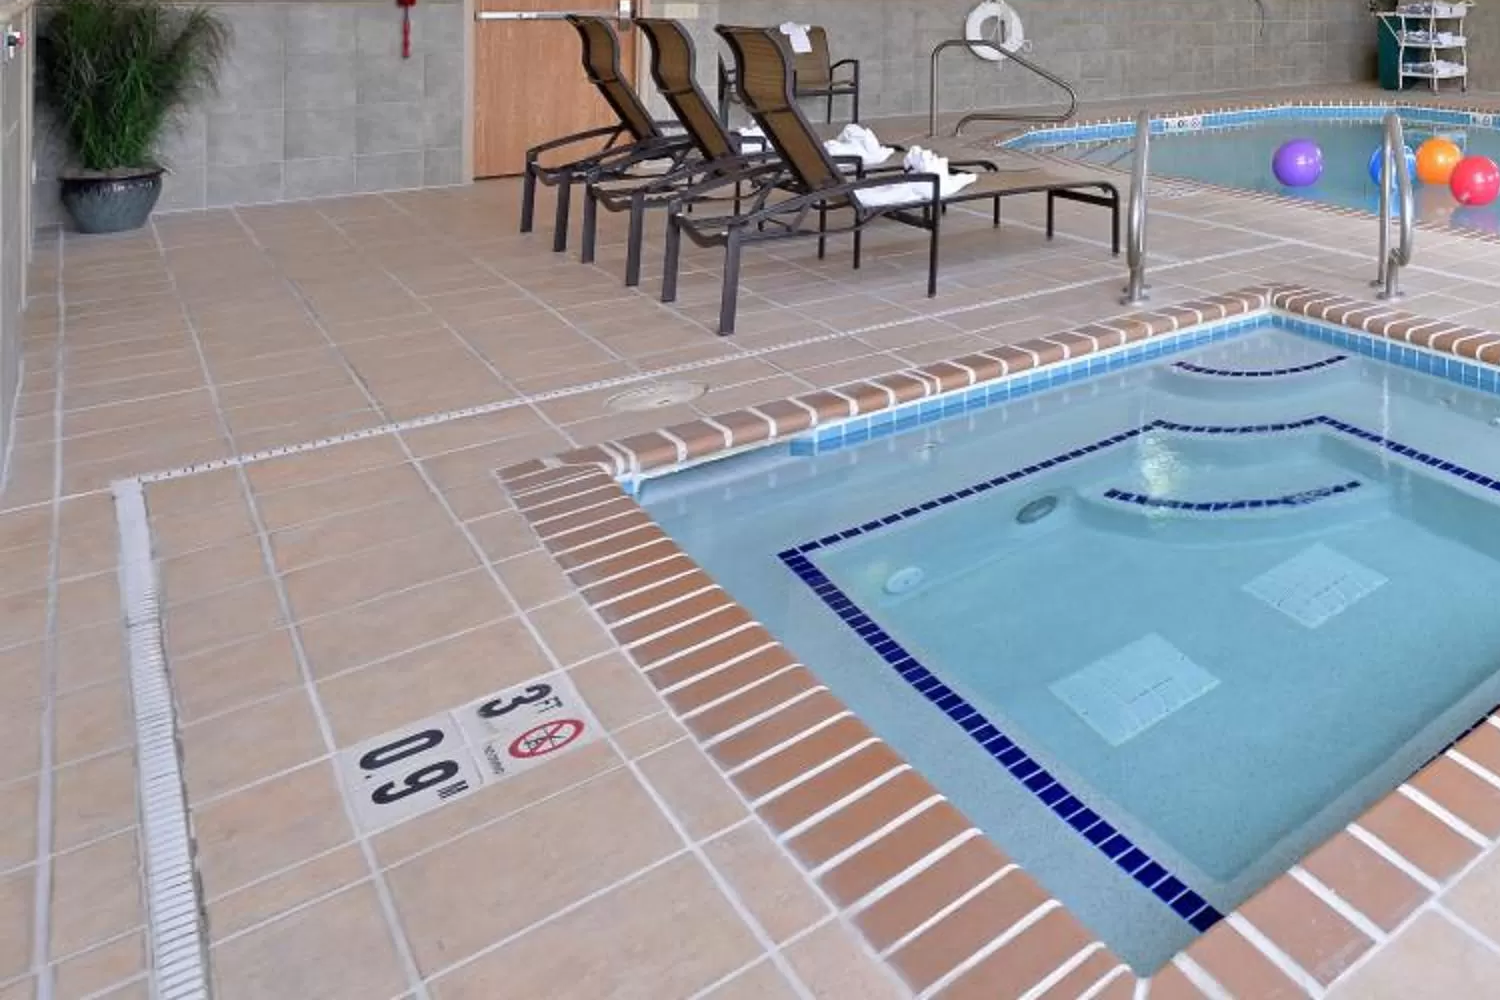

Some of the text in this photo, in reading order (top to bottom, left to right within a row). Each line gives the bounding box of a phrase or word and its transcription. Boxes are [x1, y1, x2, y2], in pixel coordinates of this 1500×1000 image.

[477, 683, 563, 718] 3 FT
[359, 729, 459, 805] 0.9
